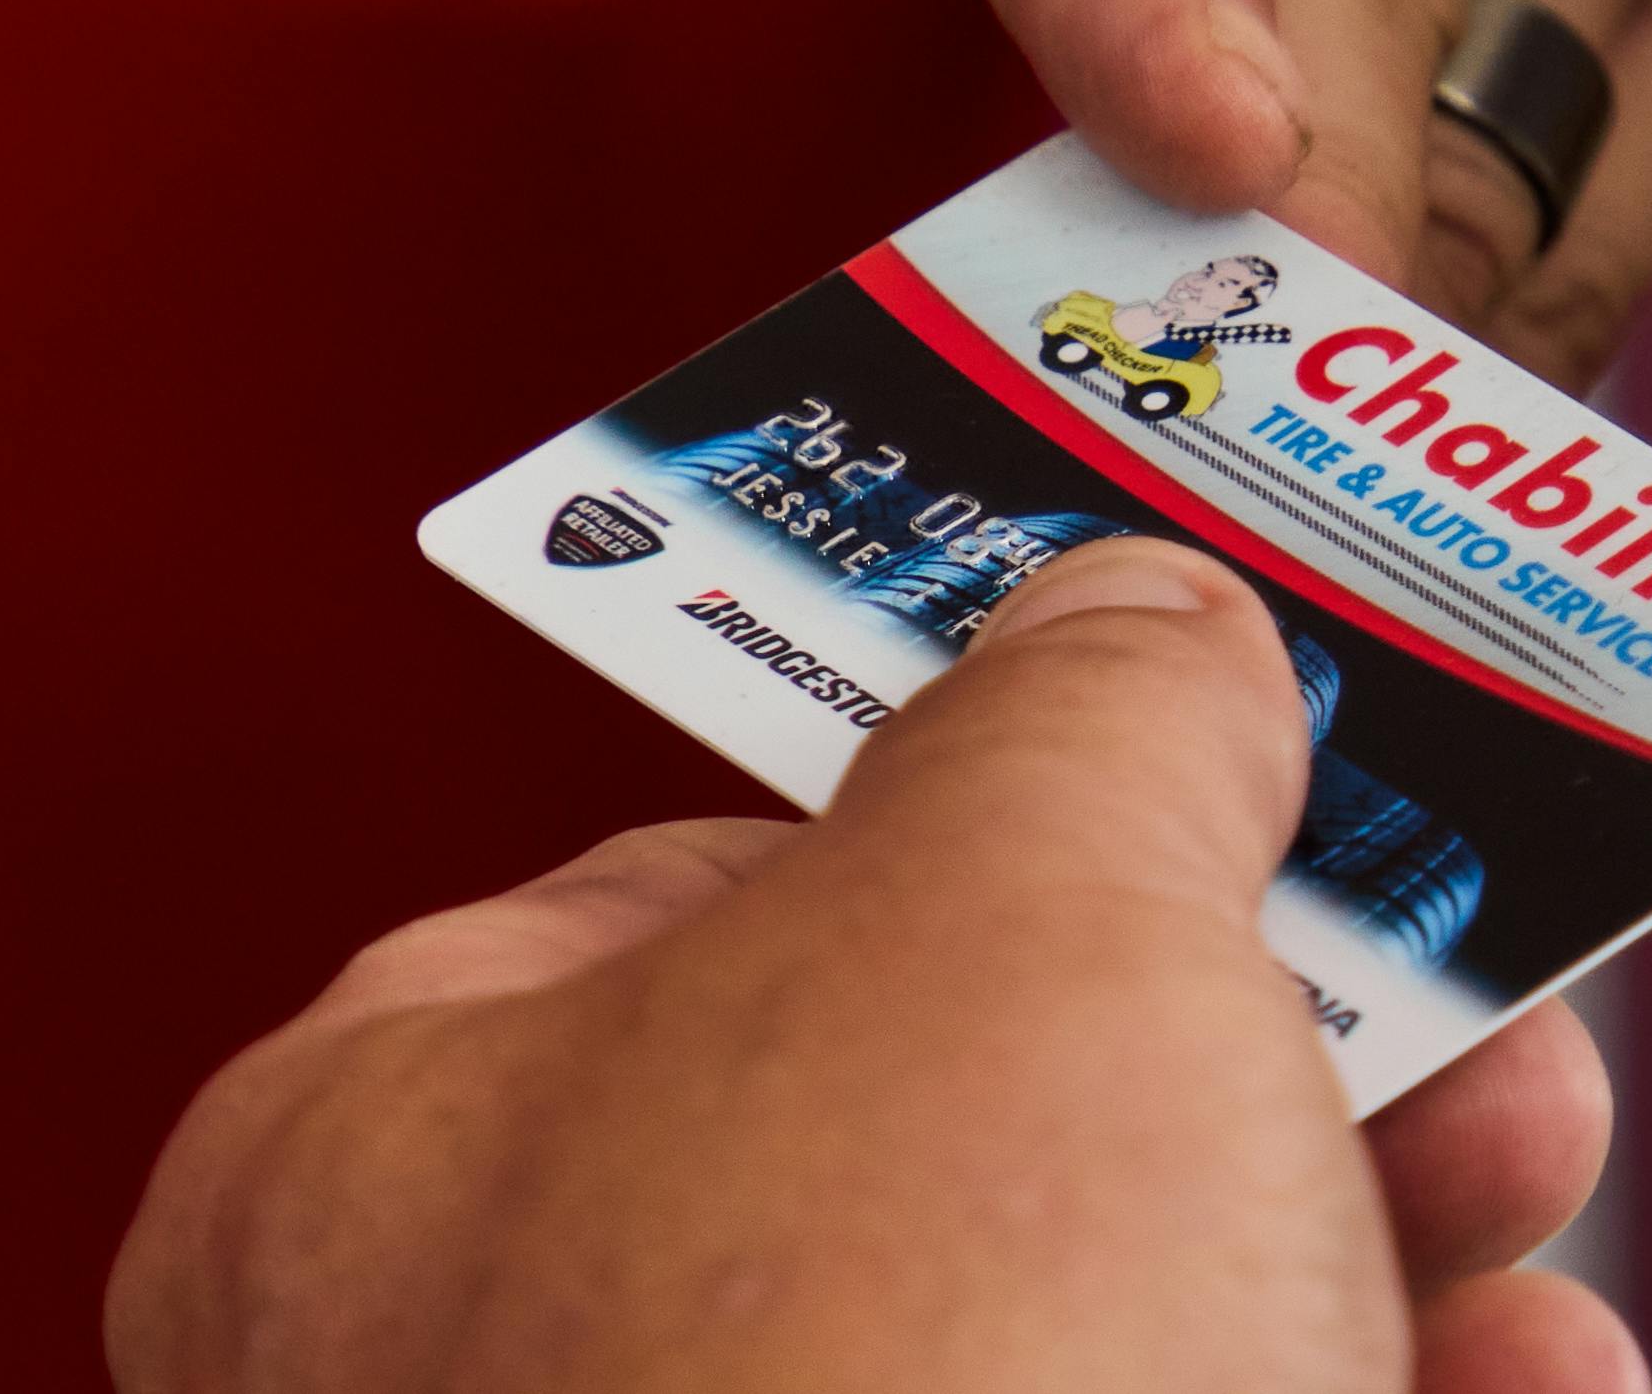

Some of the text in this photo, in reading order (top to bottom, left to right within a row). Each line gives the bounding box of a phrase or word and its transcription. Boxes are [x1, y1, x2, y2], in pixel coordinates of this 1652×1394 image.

[1104, 339, 1163, 373] CHECKER
[756, 397, 907, 501] 262
[1249, 404, 1354, 475] TIRE
[1336, 463, 1387, 500] &
[1373, 489, 1512, 571] AUTO
[561, 512, 631, 559] RETAILER
[573, 499, 652, 551] AFFILIATED
[711, 462, 890, 580] JESSIE
[675, 589, 899, 729] BRIDGESTO
